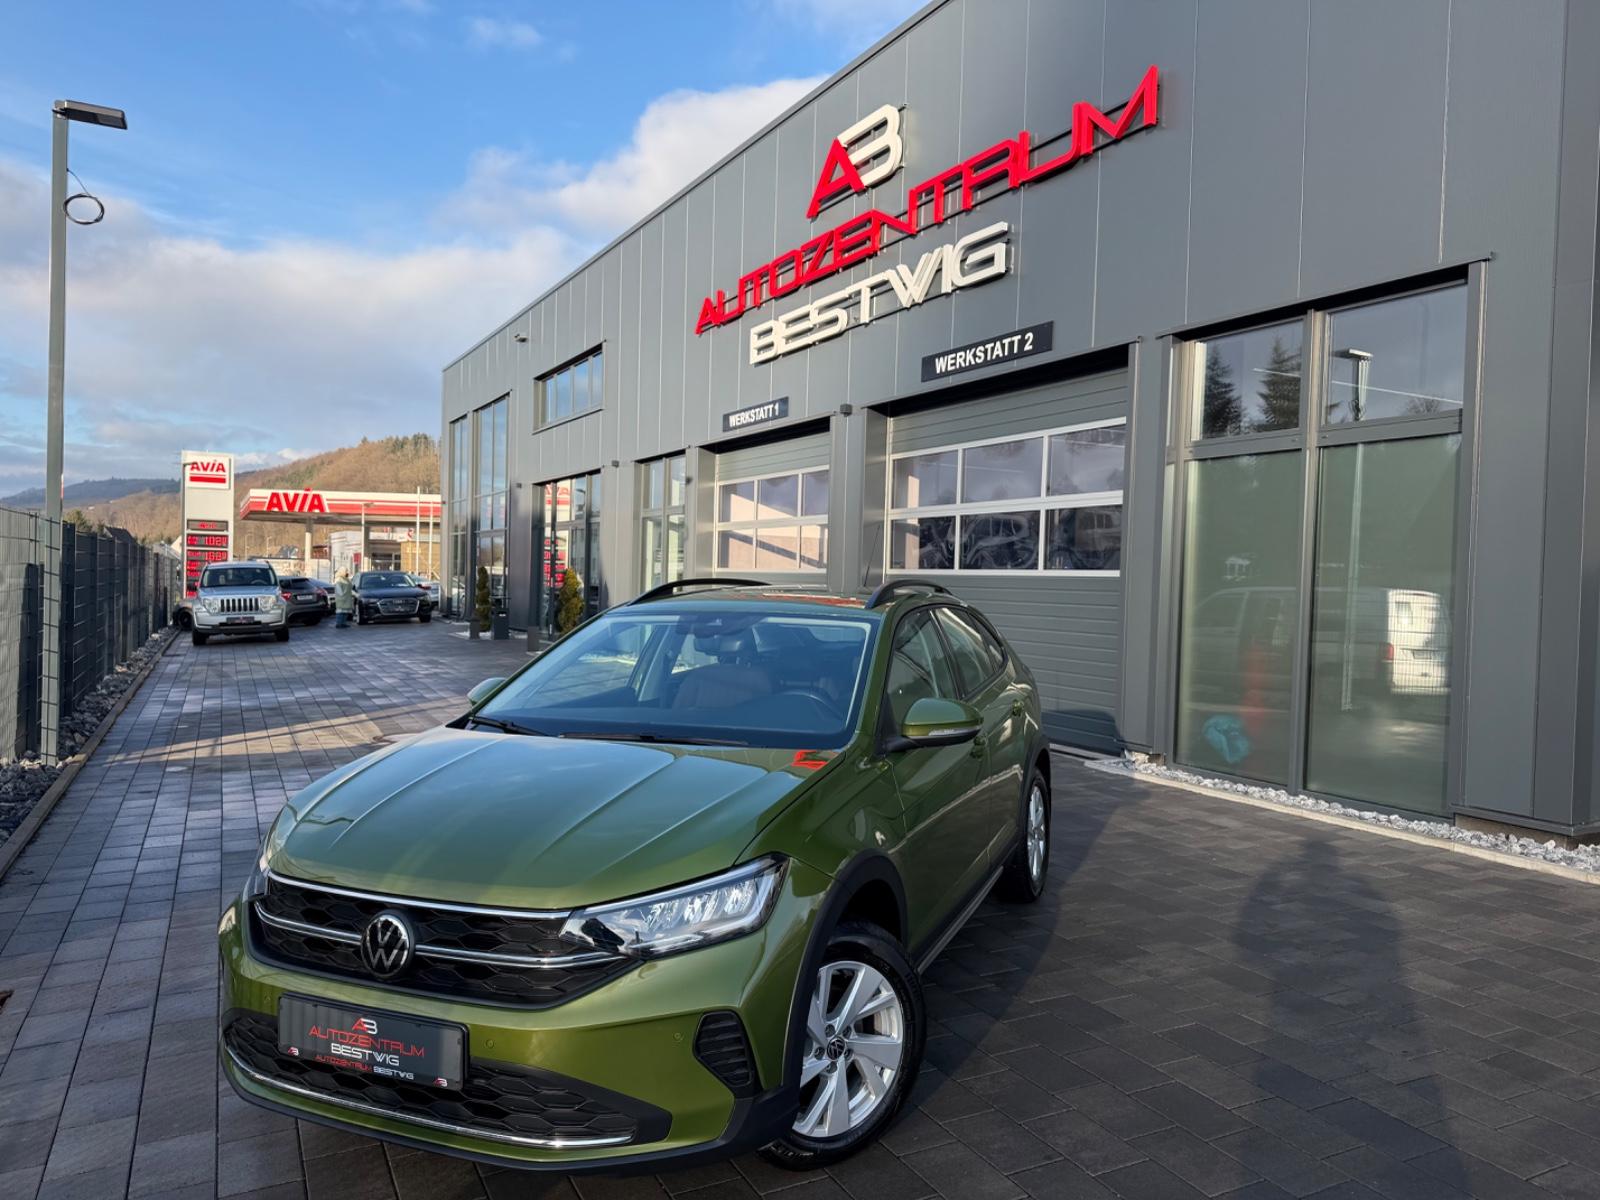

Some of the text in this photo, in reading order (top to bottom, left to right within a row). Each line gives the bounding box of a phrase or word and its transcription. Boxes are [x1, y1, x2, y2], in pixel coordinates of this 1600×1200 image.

[695, 65, 1160, 334] AUTOZENTRUM
[749, 221, 1010, 365] BESTWIG
[935, 332, 1034, 374] WERKSTATT 2
[729, 403, 774, 427] WERKSTATT
[190, 460, 226, 473] AVIA
[265, 487, 326, 513] AVIA
[308, 1024, 425, 1058] AUTOZENTRUM
[331, 1042, 400, 1066] BESTWIG
[314, 1054, 415, 1081] AUTOZENTRUM BESTWIG
